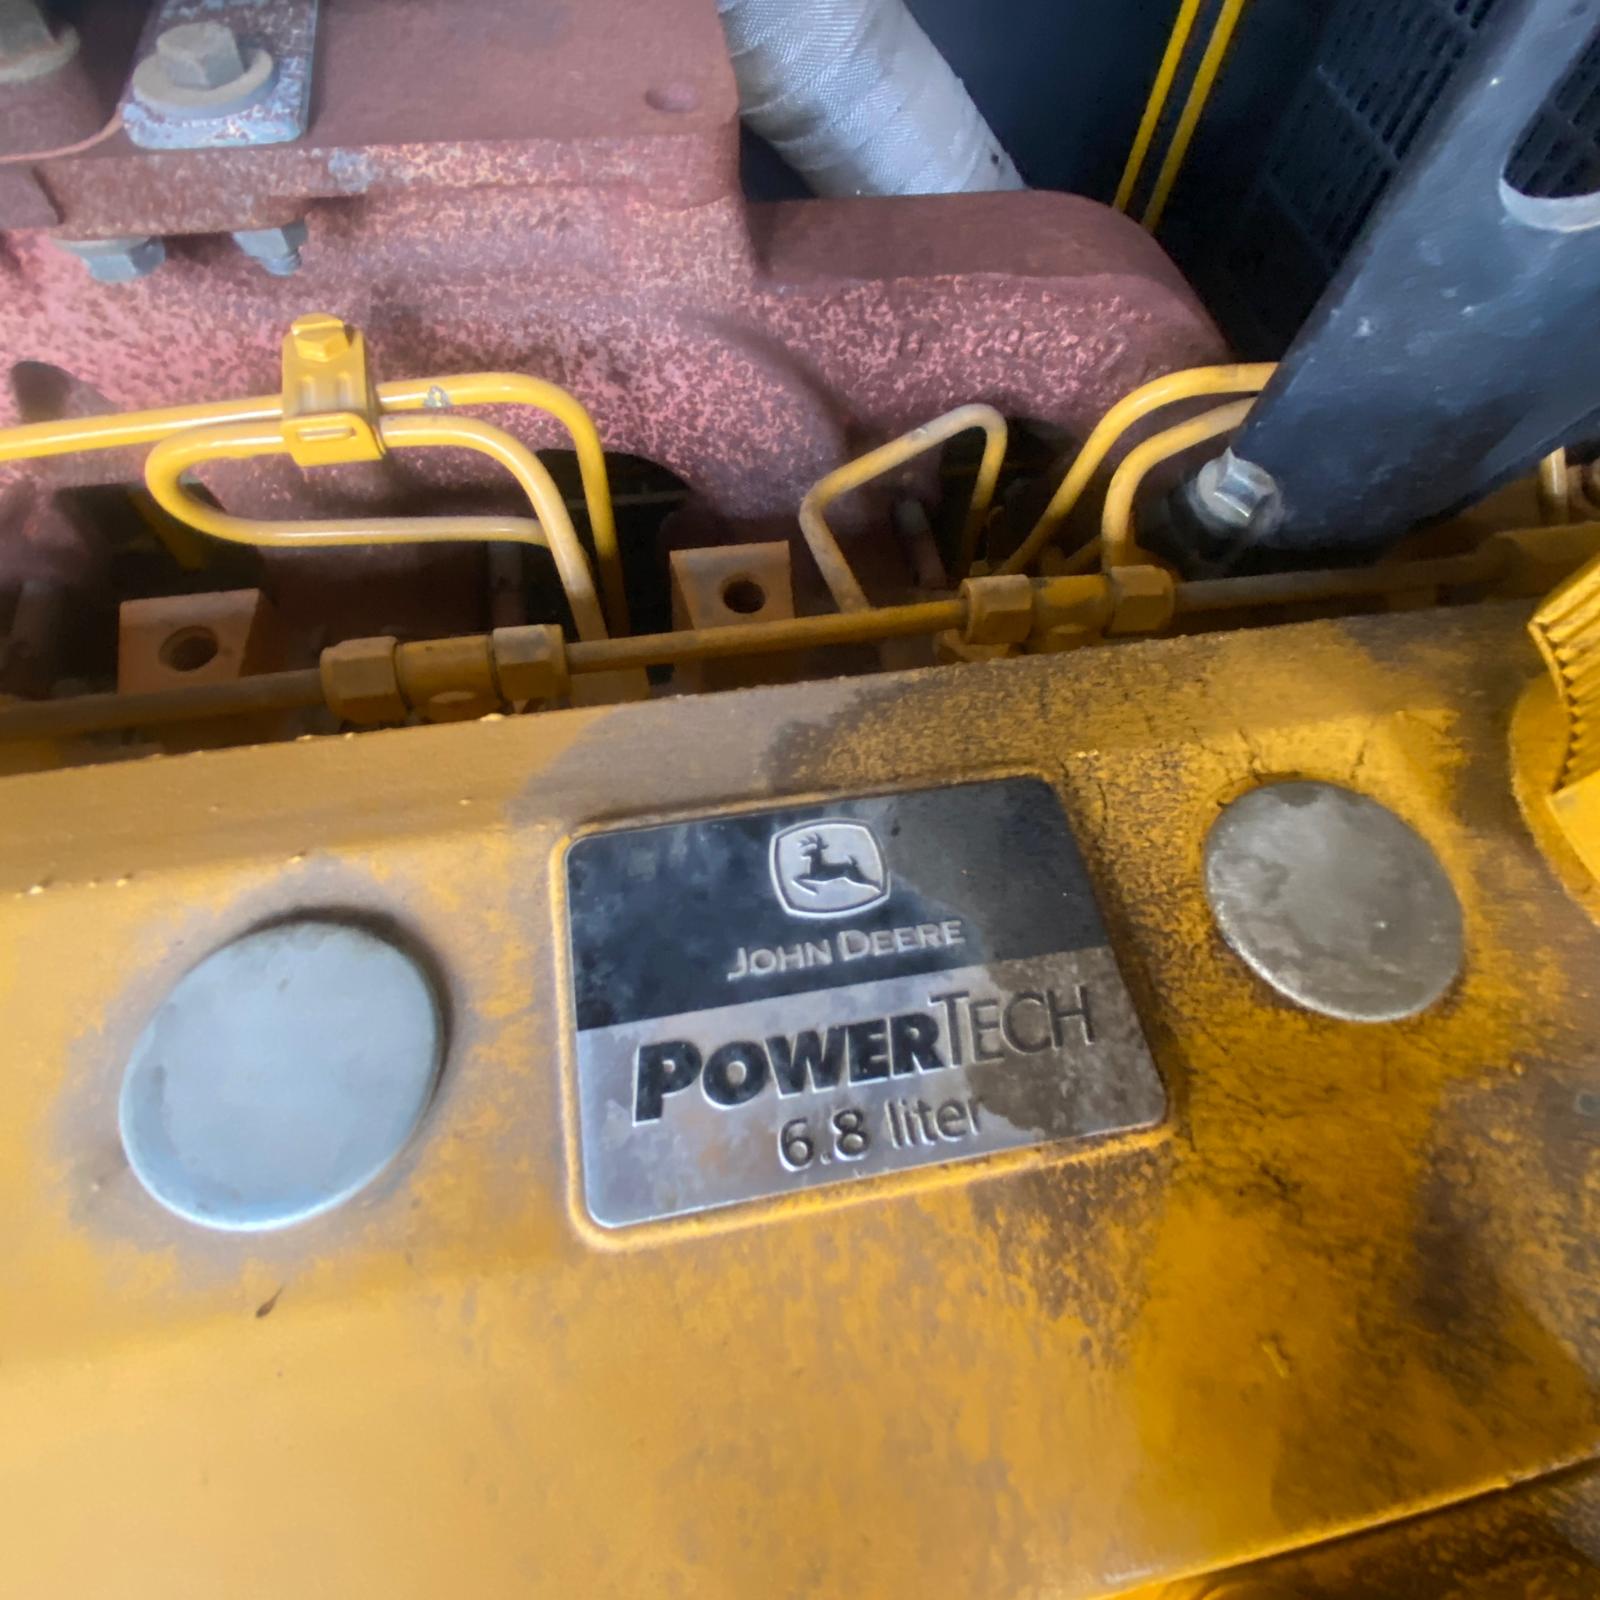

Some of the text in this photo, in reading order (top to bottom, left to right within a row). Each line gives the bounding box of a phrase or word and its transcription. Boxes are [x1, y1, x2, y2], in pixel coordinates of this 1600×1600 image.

[727, 920, 966, 981] JOHN DEERE
[777, 1098, 983, 1172] 6.8 liter
